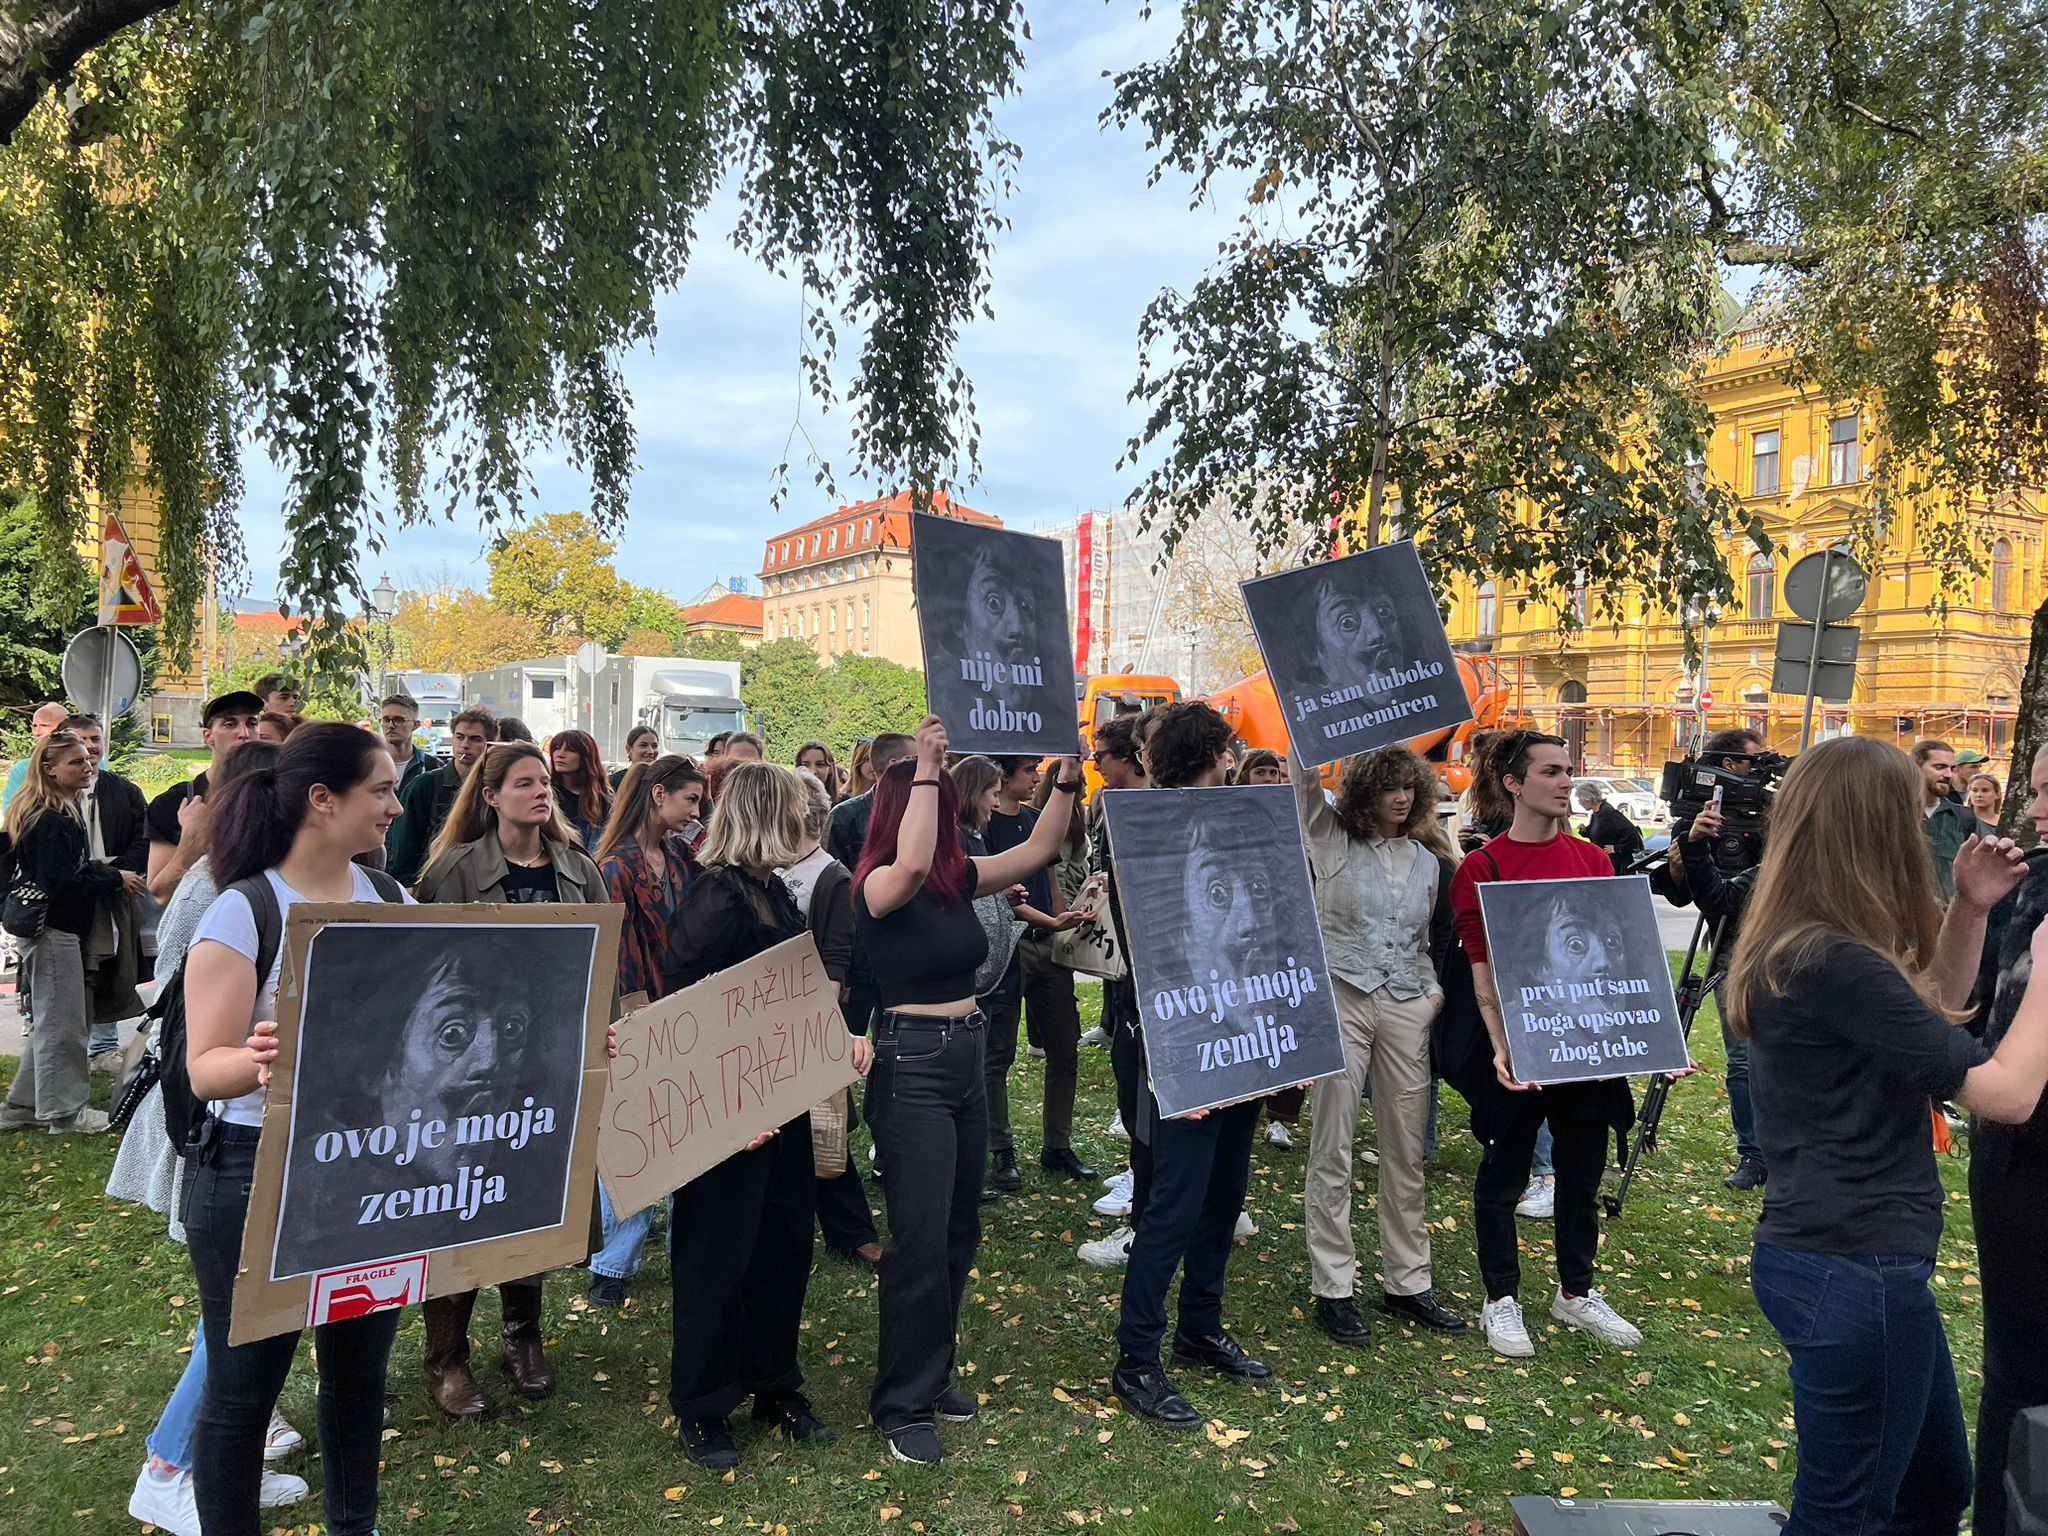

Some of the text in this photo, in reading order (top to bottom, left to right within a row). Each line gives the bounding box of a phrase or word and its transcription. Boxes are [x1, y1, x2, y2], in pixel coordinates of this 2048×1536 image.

[1092, 541, 1104, 600] Baumit
[960, 651, 1043, 692] nije mi
[1294, 660, 1444, 722] ja sam duboko
[969, 698, 1042, 733] dobro
[1322, 694, 1439, 739] uznemiren
[721, 953, 818, 1028] TRAŽILE
[1154, 956, 1318, 1023] ovo je moja
[1520, 977, 1651, 1008] prvi put sam
[1196, 1014, 1299, 1073] zemlja
[1521, 1008, 1661, 1037] Boga opsovao
[1549, 1035, 1649, 1066] zbog tebe
[612, 1070, 712, 1178] SADA
[716, 1007, 847, 1119] TRAŽIMO
[314, 1096, 557, 1166] ovo je moja
[357, 1165, 508, 1226] zemlja
[346, 1267, 397, 1285] FRAGILE
